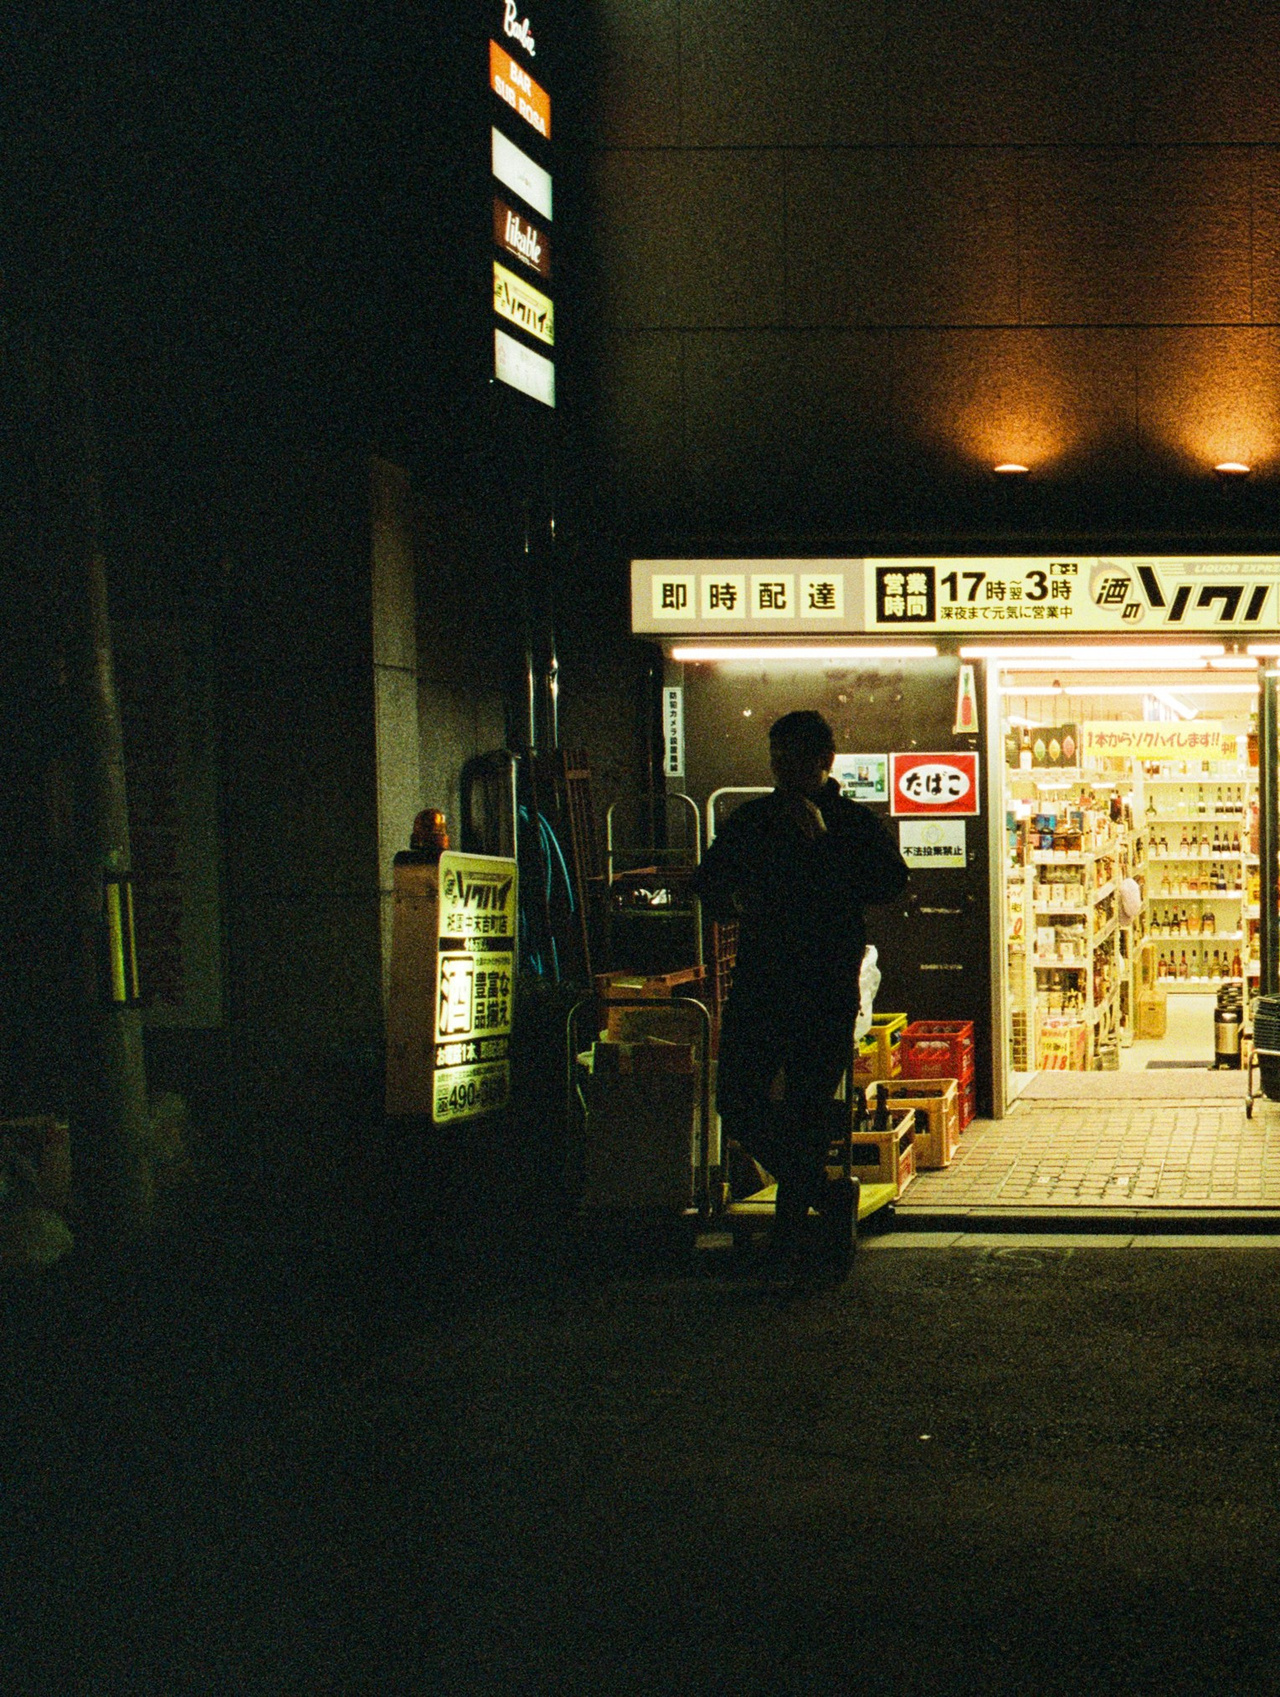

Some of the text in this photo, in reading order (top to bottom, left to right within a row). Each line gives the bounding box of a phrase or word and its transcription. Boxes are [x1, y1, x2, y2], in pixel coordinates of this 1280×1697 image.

[510, 61, 532, 97] BAR
[495, 75, 546, 137] SUB ROSA
[505, 210, 541, 263] likable
[1194, 564, 1239, 573] LIQUOR
[661, 582, 836, 610] 即時配達
[884, 573, 927, 595] 営業
[884, 595, 927, 617] 時間
[906, 771, 961, 796] たばこ
